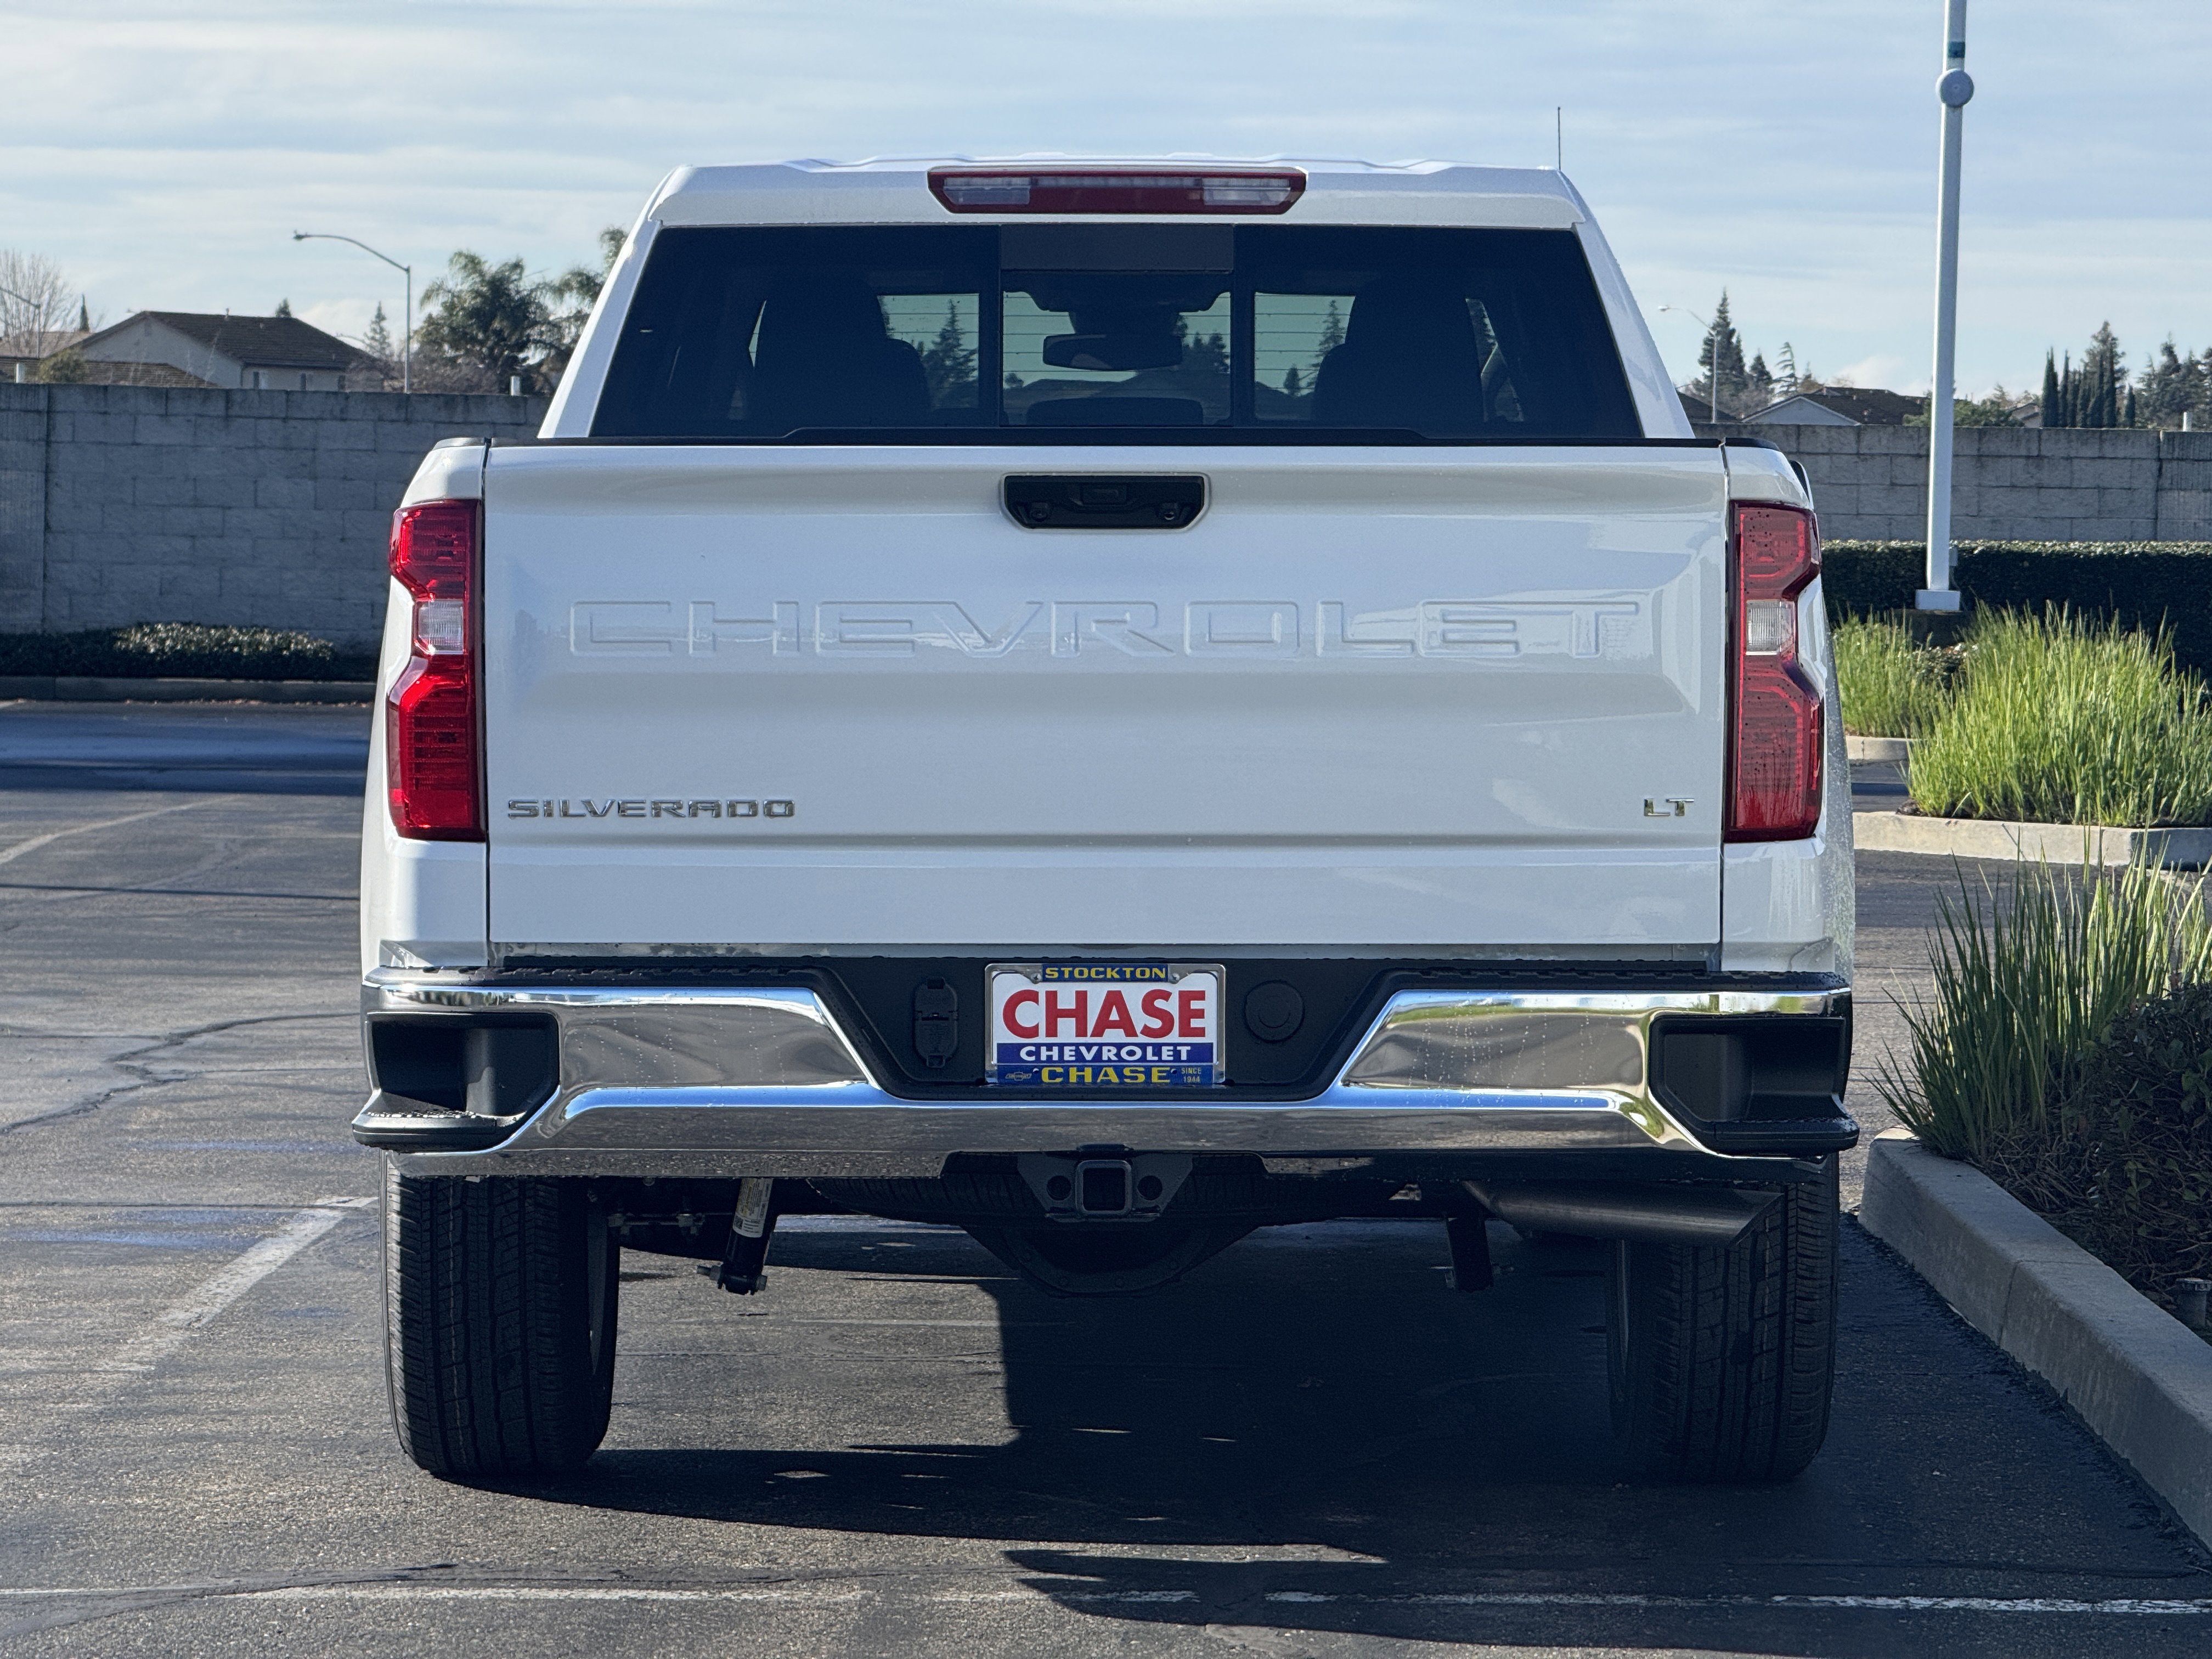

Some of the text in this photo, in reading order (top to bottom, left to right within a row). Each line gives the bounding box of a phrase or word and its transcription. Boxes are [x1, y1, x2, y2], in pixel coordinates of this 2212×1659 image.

[569, 600, 1640, 658] CHEVROLET
[508, 799, 795, 818] SILVERADO
[1644, 798, 1695, 816] LT
[1045, 967, 1166, 979] STOCKTON
[1002, 989, 1206, 1039] CHASE
[1019, 1046, 1191, 1061] CHEVROLET
[1041, 1066, 1171, 1083] CHASE
